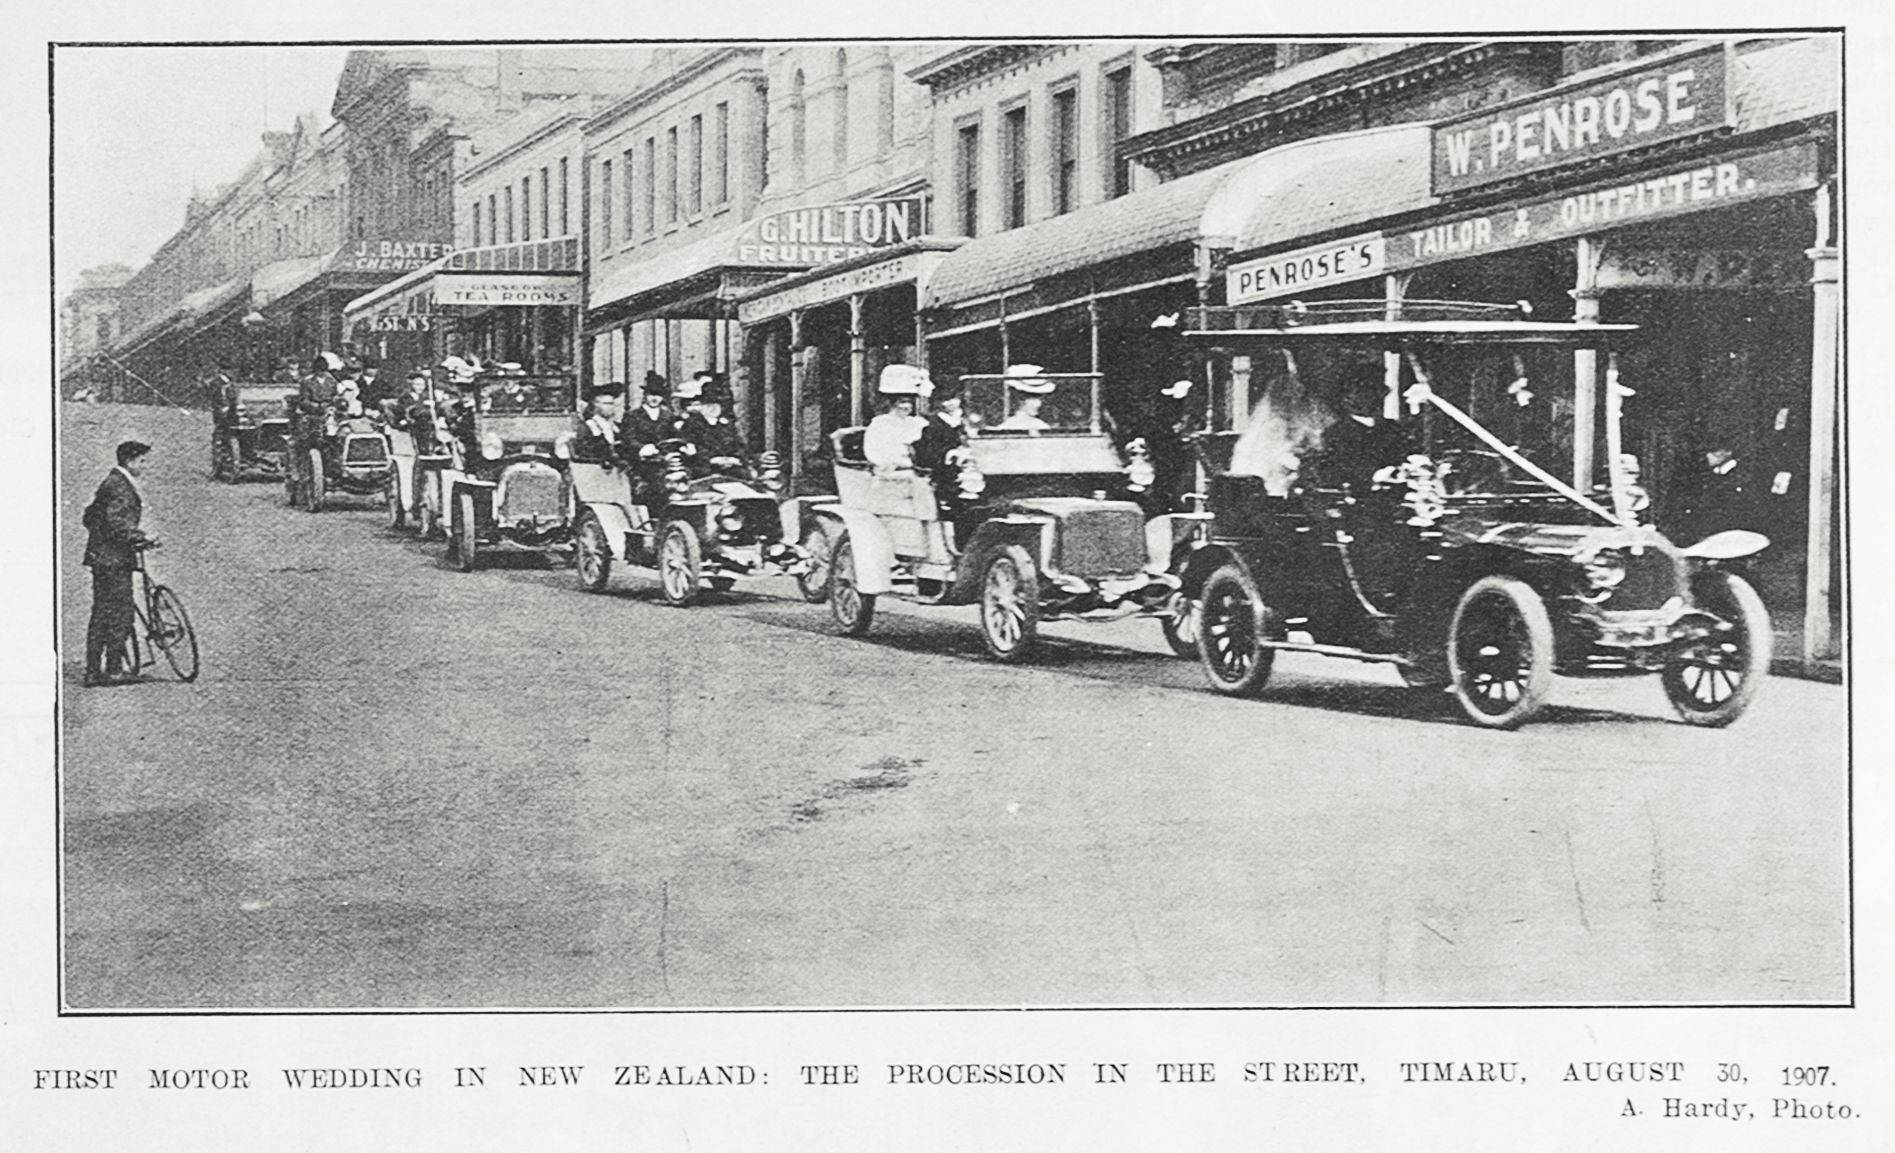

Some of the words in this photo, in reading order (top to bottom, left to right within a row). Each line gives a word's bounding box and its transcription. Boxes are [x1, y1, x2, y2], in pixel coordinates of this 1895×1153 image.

[1409, 217, 1492, 258] TAILOR
[1514, 208, 1530, 239] &
[1558, 163, 1756, 227] OUTFITTER.
[1240, 244, 1372, 294] PENROSE'S
[454, 291, 488, 301] TEA
[502, 291, 568, 302] ROOMS
